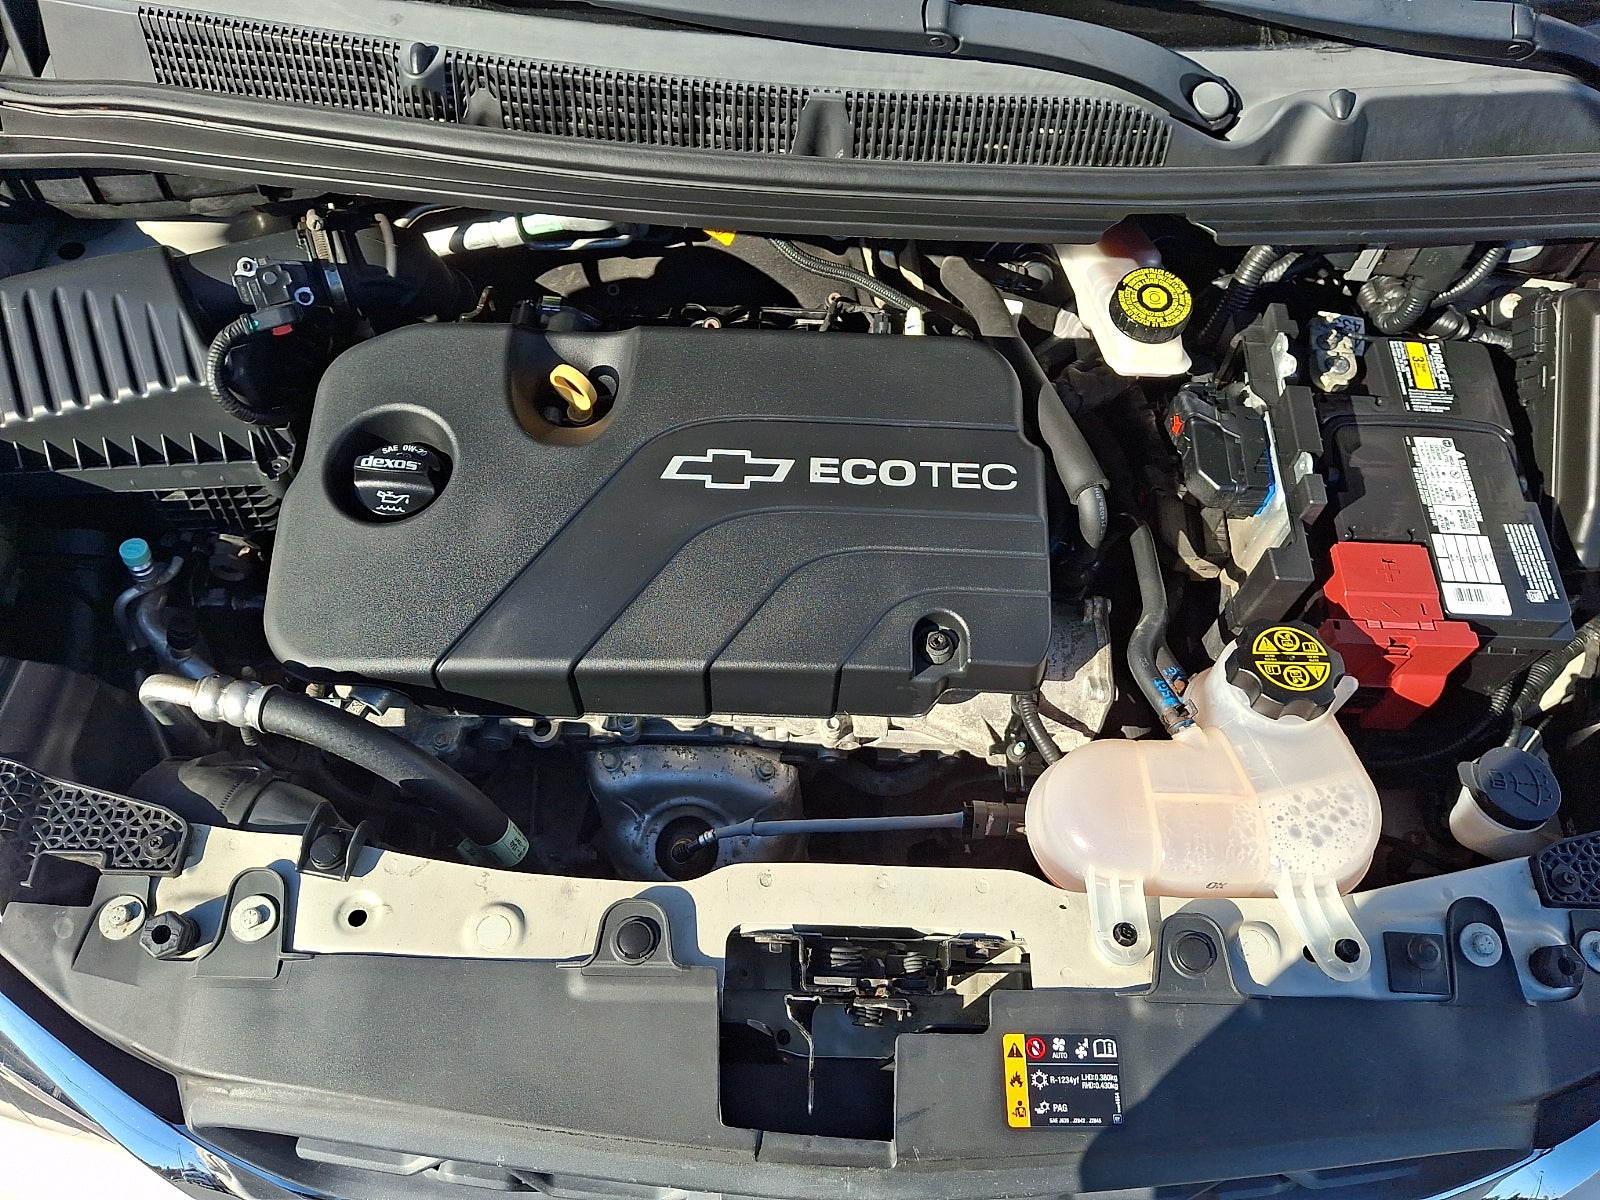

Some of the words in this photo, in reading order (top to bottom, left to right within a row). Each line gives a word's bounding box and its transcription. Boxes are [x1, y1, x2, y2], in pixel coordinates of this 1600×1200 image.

[1428, 342, 1452, 391] DURACELL
[381, 444, 399, 454] SAE
[360, 455, 418, 471] dexos
[809, 456, 1018, 491] ECOTEC
[1050, 1075, 1080, 1086] R-1234yf
[1052, 1103, 1068, 1112] PAG
